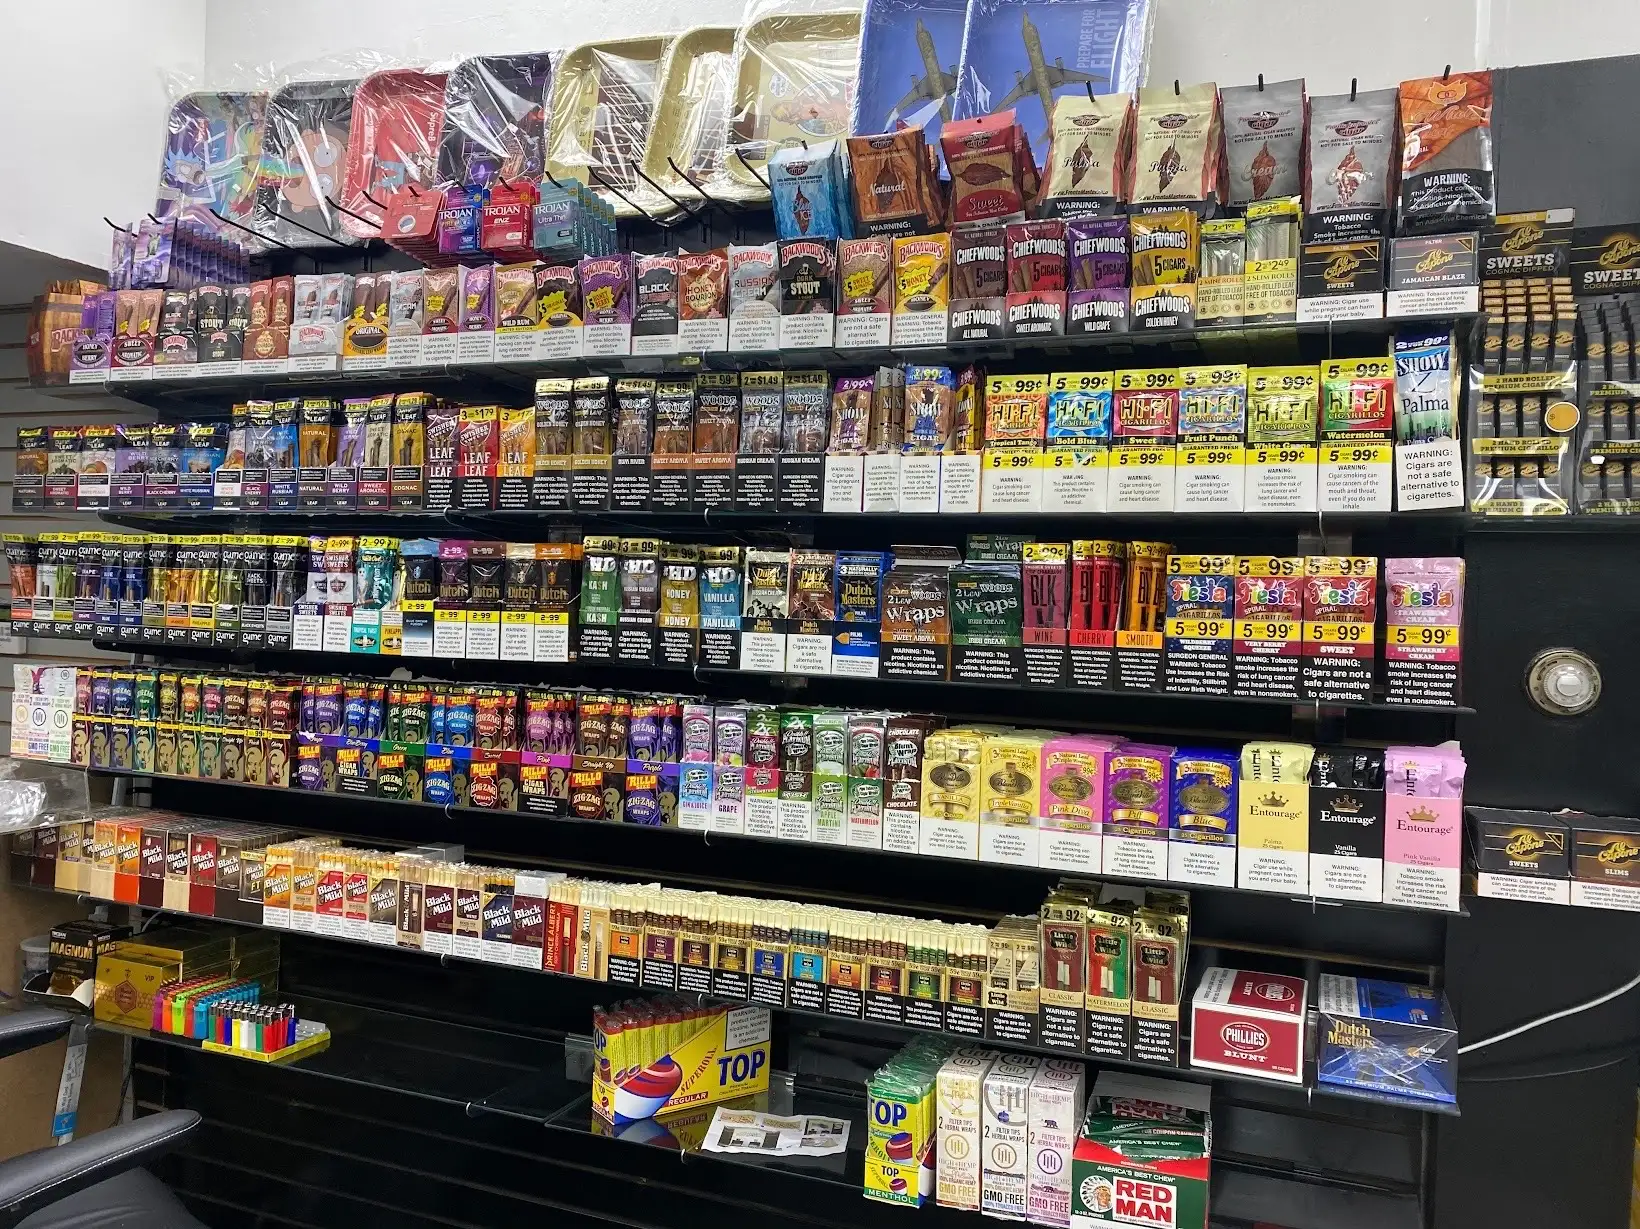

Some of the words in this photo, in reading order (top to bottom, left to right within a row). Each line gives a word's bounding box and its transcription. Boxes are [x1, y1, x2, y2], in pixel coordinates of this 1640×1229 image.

[1082, 9, 1095, 24] FOR
[1090, 9, 1120, 68] FLIGHT
[1077, 26, 1094, 68] PREPARE
[1424, 173, 1470, 187] WARNING:
[868, 180, 906, 197] Natural
[440, 209, 473, 220] TROJAN
[484, 205, 520, 215] TROJAN
[535, 202, 569, 214] TROJAN
[1323, 213, 1373, 224] WARNING:
[870, 222, 911, 231] WARNING:
[1515, 225, 1531, 238] Al
[1074, 237, 1126, 257] CHIEFWOODS
[1134, 231, 1186, 252] CHIEFWOODS
[1502, 231, 1543, 251] Capone
[782, 242, 825, 267] BACKWOODS
[899, 242, 945, 263] BACKWOODS
[1013, 239, 1062, 258] CHIEFWOODS
[733, 252, 773, 271] BACKWOODS
[956, 246, 1005, 265] CHIEFWOODS
[1487, 254, 1555, 269] SWEETS
[1155, 256, 1162, 276] 5
[1163, 258, 1185, 269] CIGARS
[1416, 254, 1453, 273] Capone
[537, 266, 574, 286] BACKWOODS
[1486, 267, 1520, 275] COGNAC
[1402, 275, 1440, 284] JAMAICAN
[639, 283, 669, 294] BLACK
[687, 285, 715, 294] HONEY
[791, 281, 820, 294] STOUT
[1009, 303, 1060, 322] CHIEFWOODS
[1072, 301, 1124, 320] CHIEFWOODS
[1136, 296, 1189, 316] CHIEFWOODS
[952, 310, 1000, 328] CHIEFWOODS
[1397, 353, 1448, 377] SHOW
[1056, 378, 1066, 390] 5
[1080, 377, 1108, 389] 99¢
[1121, 375, 1132, 387] 5
[1146, 374, 1174, 387] 99¢
[1403, 396, 1449, 415] Palma
[1327, 431, 1384, 439] Watermelon
[464, 453, 490, 464] LEAF
[1120, 454, 1128, 465] 5
[1140, 453, 1163, 464] 99¢
[1187, 453, 1196, 463] 5
[1208, 452, 1232, 463] 99¢
[1330, 451, 1339, 461] 5
[1352, 450, 1378, 461] 99¢
[1405, 450, 1452, 460] WARNING:
[465, 465, 488, 476] LEAF
[1406, 462, 1435, 471] Cigars
[1401, 481, 1448, 491] alternative
[1407, 492, 1453, 501] cigarettes.
[78, 547, 101, 561] game
[406, 581, 431, 594] Dutch
[474, 587, 499, 599] Dutch
[845, 584, 872, 595] Dutch
[1031, 574, 1056, 606] BLK
[1170, 576, 1226, 602] Fiesta
[842, 594, 876, 605] Masters
[956, 597, 1017, 614] Wraps
[665, 616, 690, 626] HONEY
[703, 618, 735, 628] VANILLA
[1176, 622, 1184, 635] 5
[1198, 622, 1224, 636] 99¢
[1313, 626, 1323, 639] 5
[1337, 626, 1366, 640] 99¢
[268, 633, 288, 646] game
[1035, 631, 1053, 642] WINE
[1077, 633, 1106, 644] CHERRY
[1126, 634, 1153, 645] SMOOTH
[1314, 658, 1360, 667] WARNING:
[1303, 668, 1330, 677] Cigars
[1324, 680, 1370, 689] alternative
[1319, 691, 1364, 700] cigarettes.
[524, 779, 544, 788] CIGAR
[523, 786, 545, 795] WRAPS
[719, 805, 737, 813] GRAPE
[1052, 805, 1070, 813] Pink
[1072, 806, 1090, 816] Diva
[1249, 805, 1299, 820] Entourage
[1320, 810, 1374, 826] Entourage
[1396, 819, 1451, 836] Entourage
[1189, 833, 1223, 842] Cigarillos
[1518, 834, 1532, 844] Al
[1505, 840, 1544, 855] Capone
[167, 850, 187, 862] Black
[172, 859, 188, 870] Mild
[1509, 860, 1538, 868] SWEETS
[1605, 868, 1629, 876] SLIMS
[318, 881, 342, 895] Black
[324, 890, 343, 903] Mild
[425, 893, 452, 908] Black
[432, 904, 452, 916] Mild
[514, 905, 541, 919] Black
[521, 916, 542, 928] Mild
[50, 941, 93, 959] MAGNUM
[1048, 993, 1075, 1001] CLASSIC
[1087, 998, 1129, 1008] WATERMELON
[1335, 1020, 1371, 1037] Dutch
[1226, 1028, 1265, 1046] PHILLIES
[1328, 1031, 1374, 1049] Masters
[1223, 1050, 1266, 1062] BLUNT
[717, 1049, 766, 1086] TOP
[668, 1091, 708, 1106] REGULAR
[985, 1125, 990, 1138] 2
[881, 1165, 899, 1177] TOP
[1097, 1165, 1132, 1176] AMERICA'S
[1134, 1171, 1152, 1179] BEST
[868, 1189, 914, 1203] MENTHOL
[984, 1190, 1002, 1202] GMO
[1004, 1193, 1024, 1205] FREE
[1116, 1179, 1172, 1203] RED
[1116, 1199, 1172, 1223] MAN
